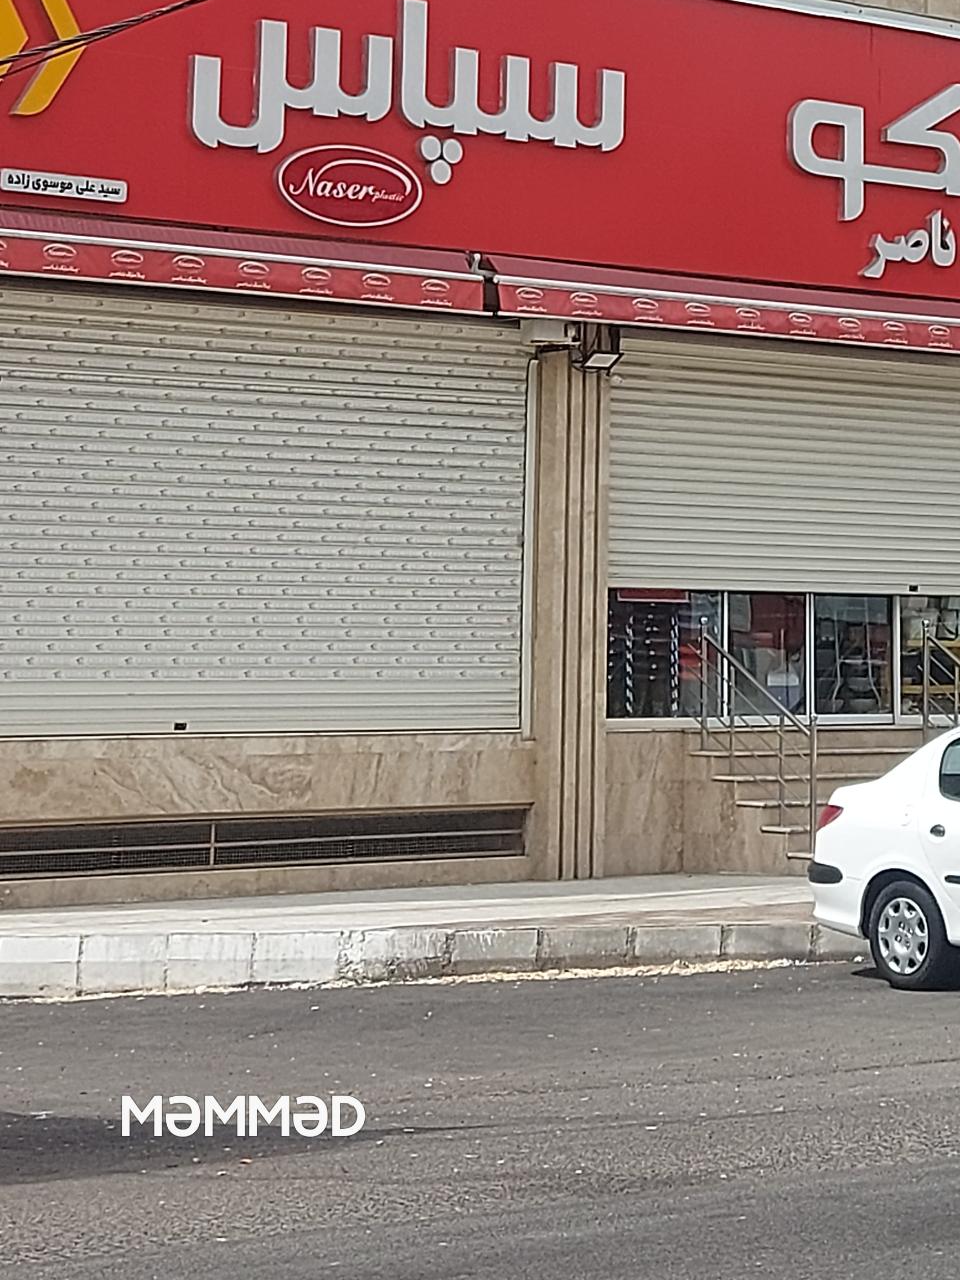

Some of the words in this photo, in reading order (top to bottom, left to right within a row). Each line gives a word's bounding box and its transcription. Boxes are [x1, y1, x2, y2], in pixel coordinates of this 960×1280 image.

[7, 173, 31, 189] زاده
[32, 178, 74, 193] موسوی
[76, 180, 96, 195] علی
[289, 164, 382, 201] Naser
[98, 183, 121, 198] سید
[859, 209, 957, 279] ناصر
